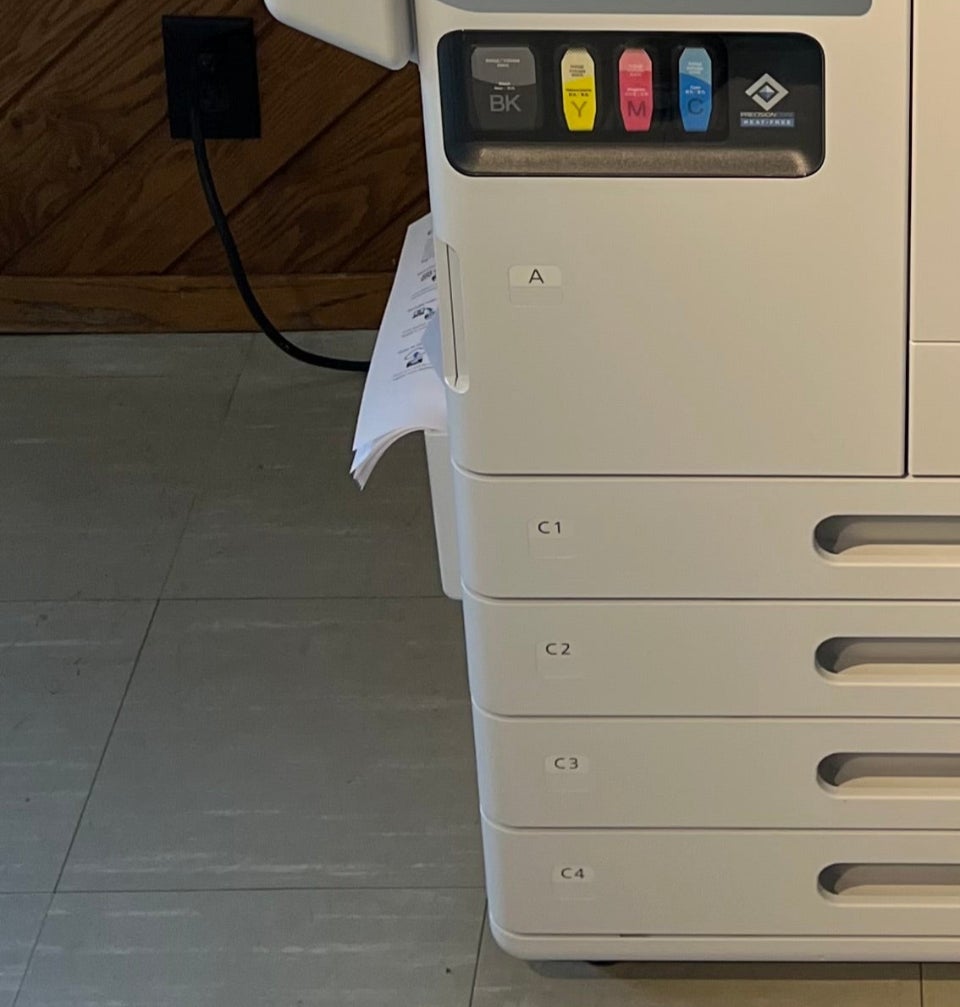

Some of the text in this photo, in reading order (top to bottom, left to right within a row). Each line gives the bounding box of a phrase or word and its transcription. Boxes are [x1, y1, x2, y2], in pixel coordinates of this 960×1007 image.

[489, 94, 522, 113] BK
[570, 100, 588, 118] Y
[627, 99, 646, 118] M
[687, 97, 704, 116] C
[528, 269, 545, 284] A
[537, 520, 562, 535] C1
[545, 642, 571, 656] C2
[554, 756, 579, 770] C3
[560, 867, 585, 880] C4
